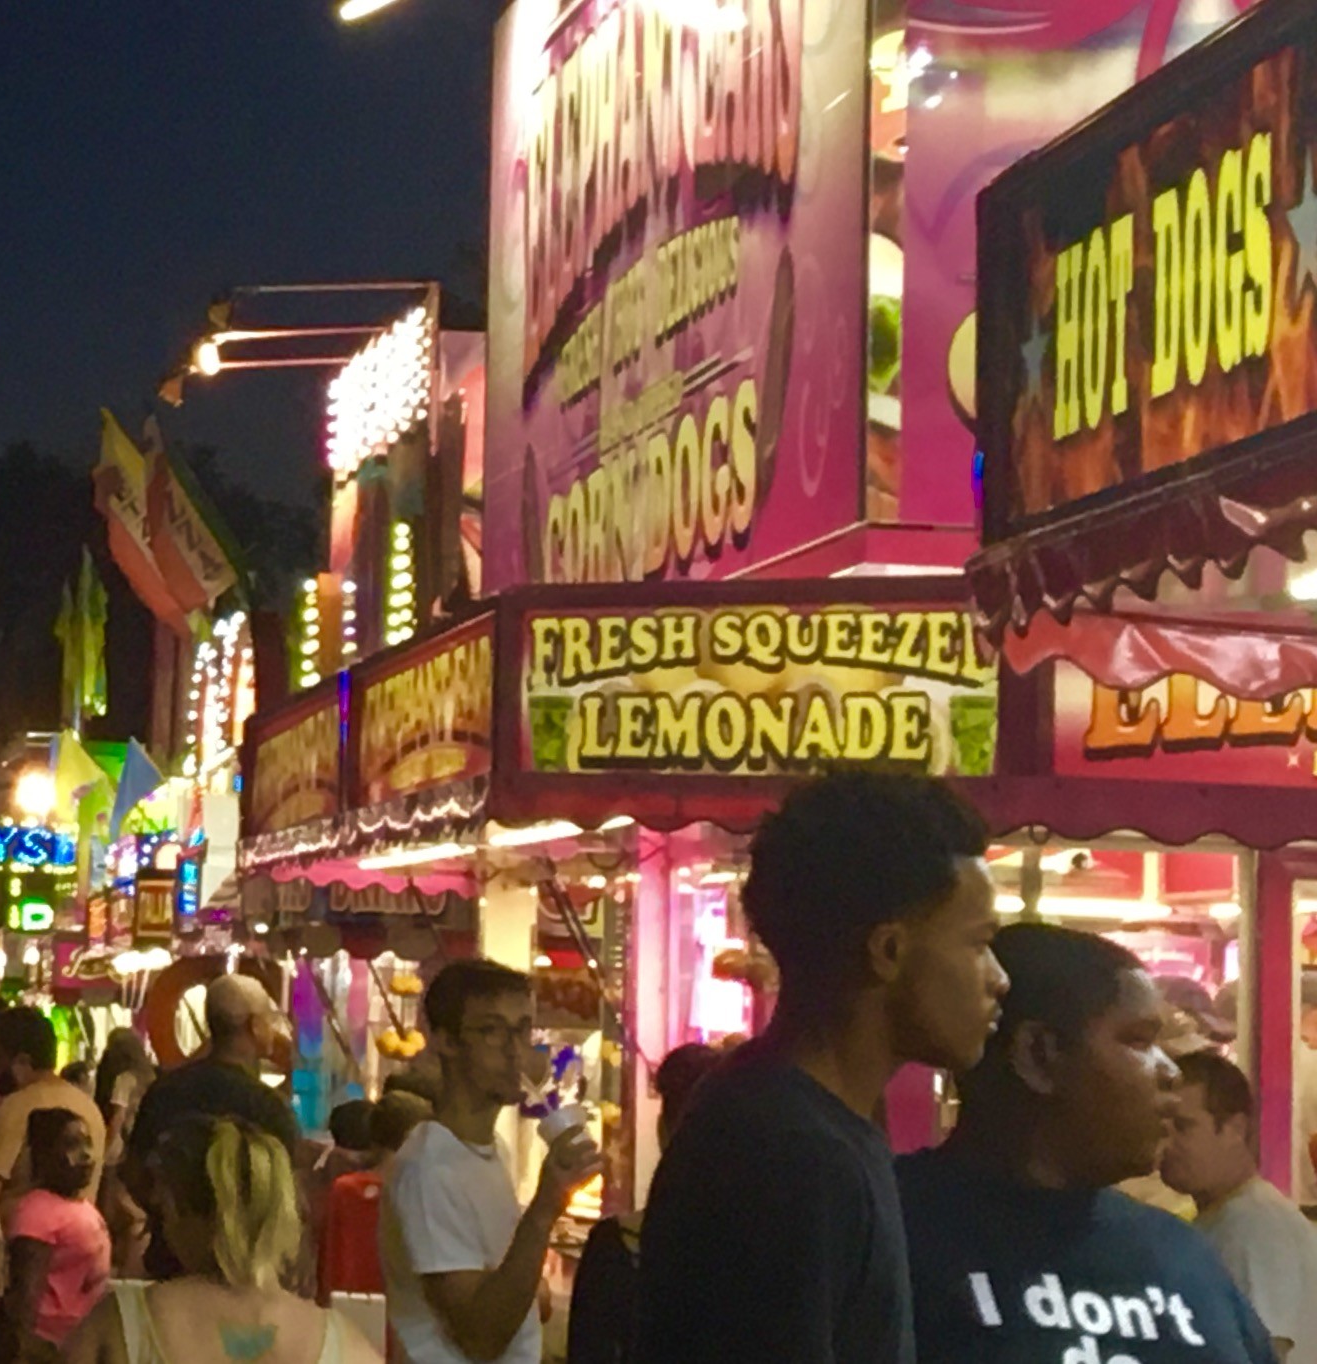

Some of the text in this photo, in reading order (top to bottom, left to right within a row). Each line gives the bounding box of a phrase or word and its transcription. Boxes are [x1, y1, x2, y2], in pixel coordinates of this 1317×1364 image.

[1054, 133, 1272, 441] HOT DOGS
[642, 378, 758, 572] DOGS
[531, 612, 702, 688] FRESH
[578, 695, 931, 763] LEMONADE
[1082, 671, 1317, 757] ELE
[968, 1272, 1206, 1346] I don't
